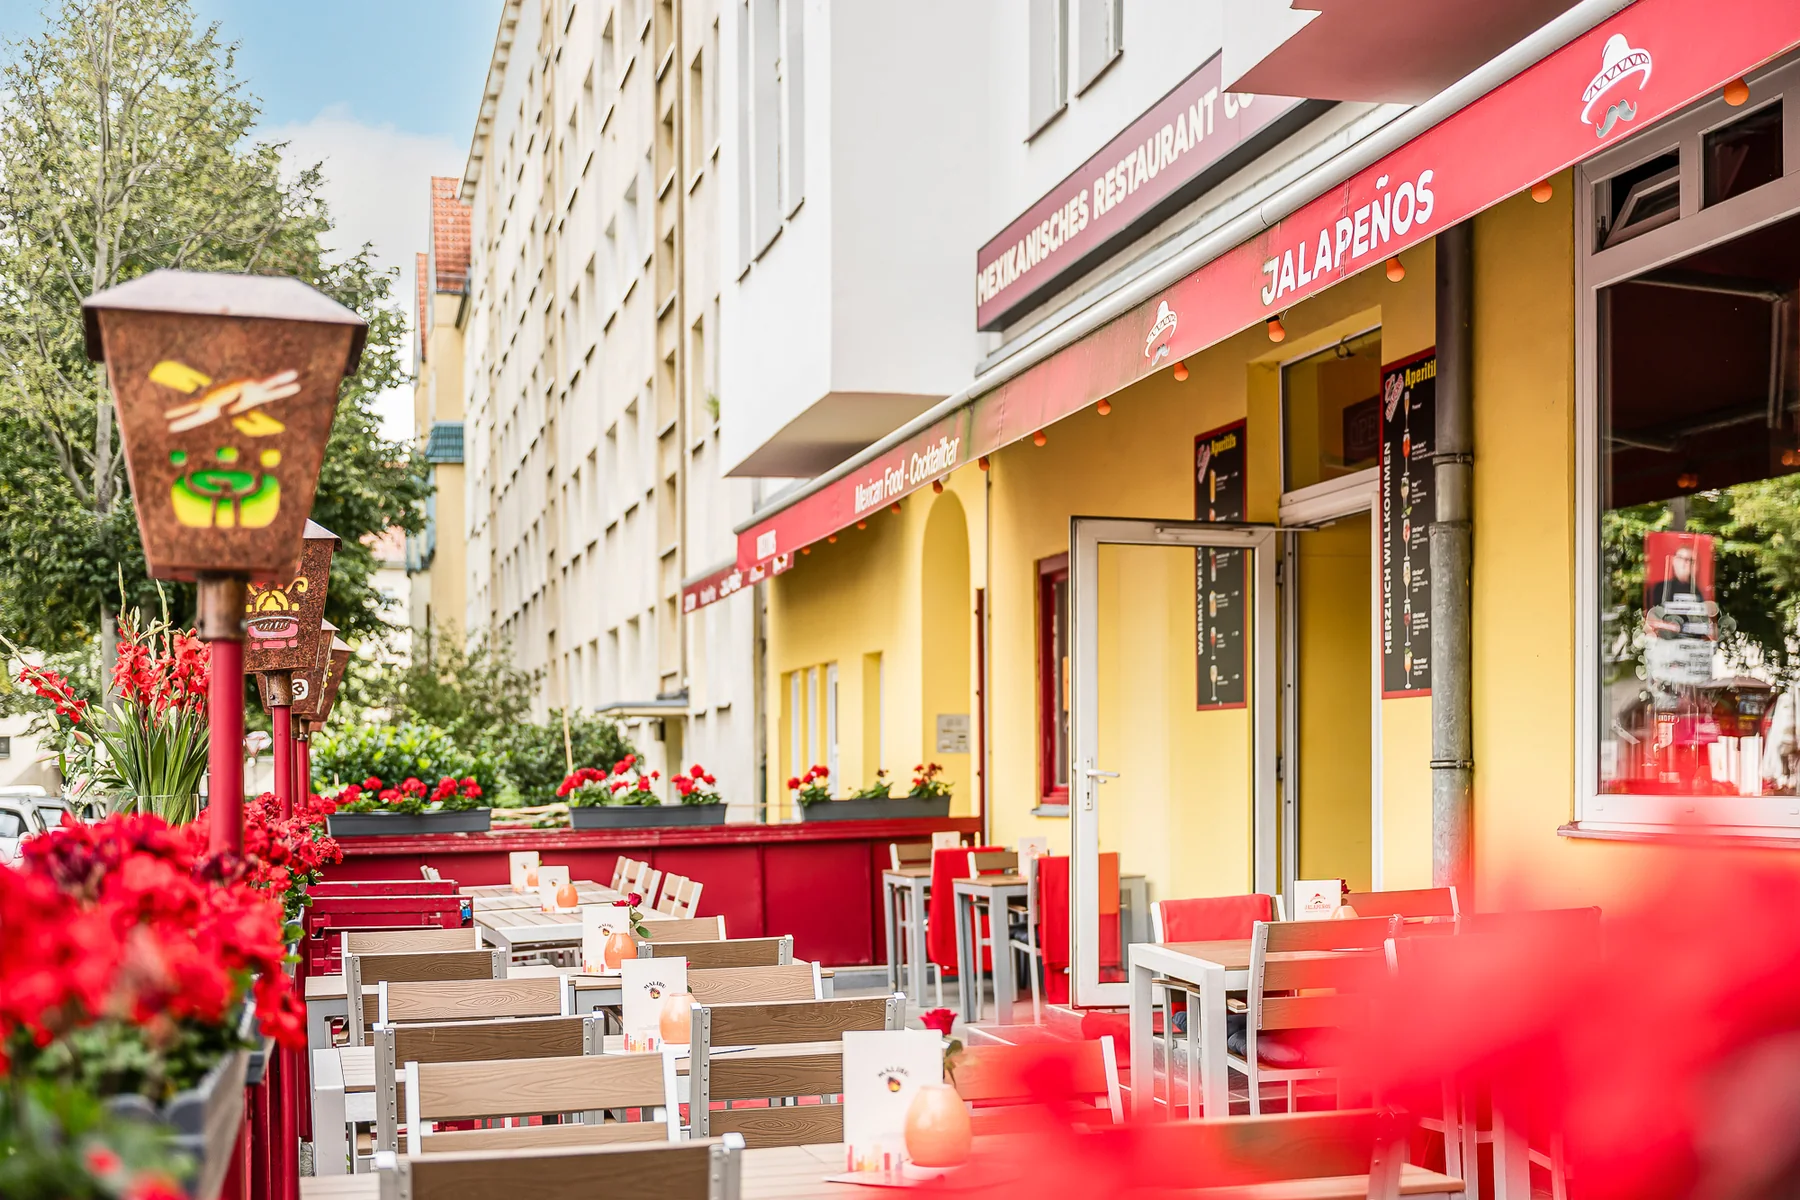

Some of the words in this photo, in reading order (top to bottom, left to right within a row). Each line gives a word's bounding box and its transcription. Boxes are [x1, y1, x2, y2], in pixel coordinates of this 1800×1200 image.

[977, 188, 1090, 308] MEXIKANISCHES
[1093, 86, 1218, 220] RESTAURANT
[1261, 168, 1435, 307] JALAPEÑOS
[854, 478, 884, 515] Mexican
[883, 459, 905, 499] Food
[909, 436, 960, 486] Cocktailbar
[1383, 441, 1392, 566] WILLKOMMEN
[1383, 567, 1392, 655] HERZLICH
